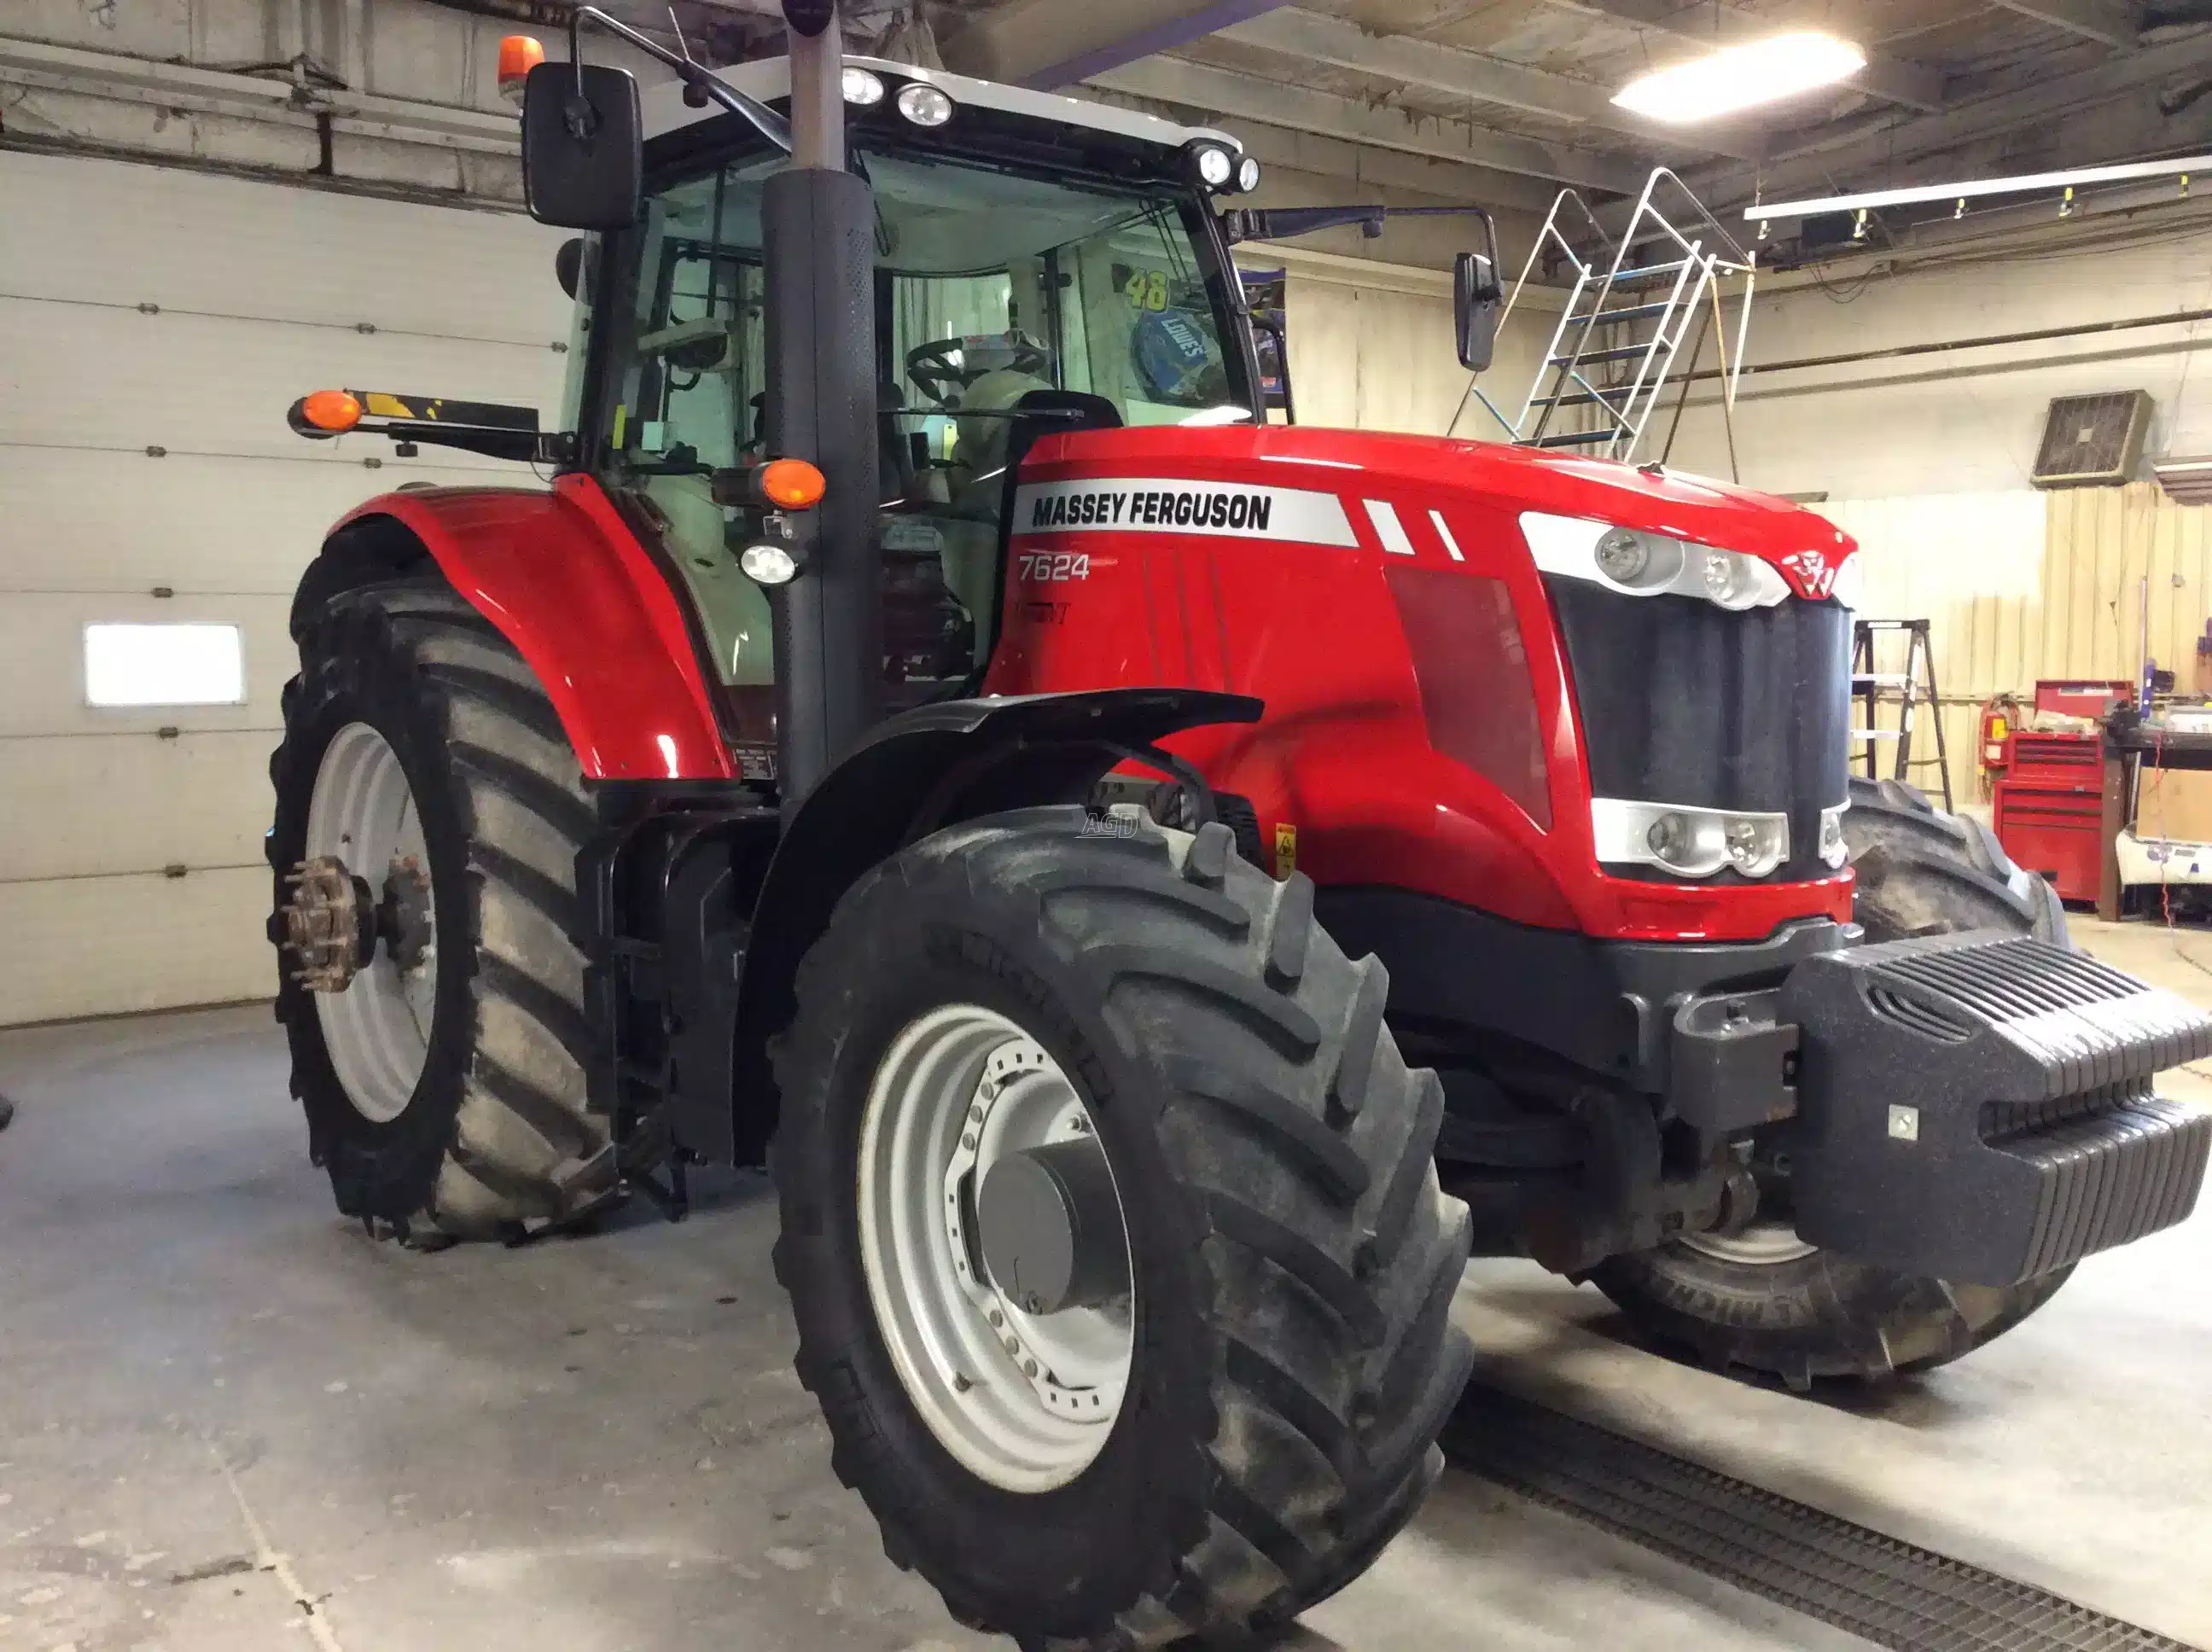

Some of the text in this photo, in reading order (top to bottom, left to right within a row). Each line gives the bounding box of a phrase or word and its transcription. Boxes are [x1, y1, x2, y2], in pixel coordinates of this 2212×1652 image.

[1126, 270, 1168, 311] 48
[1032, 492, 1272, 531] MASSEY FERGUSON
[1019, 554, 1090, 581] 7624
